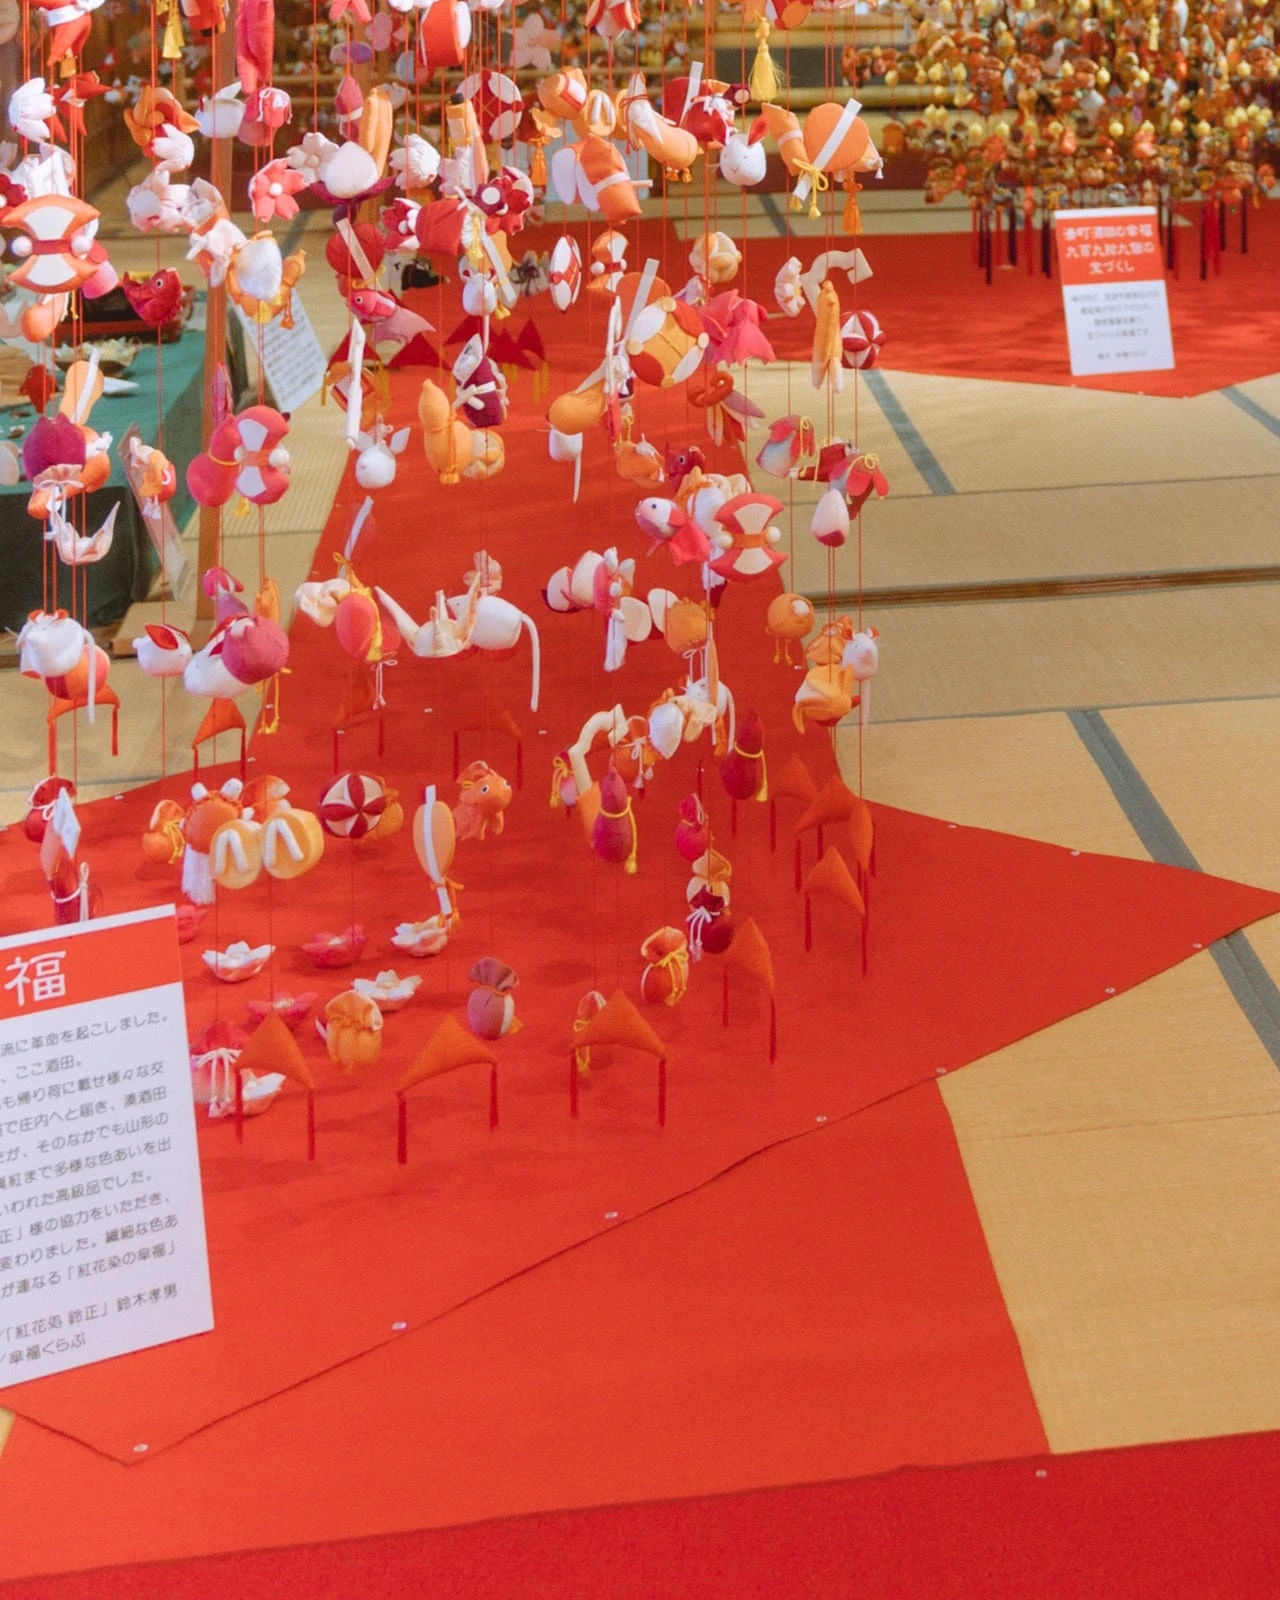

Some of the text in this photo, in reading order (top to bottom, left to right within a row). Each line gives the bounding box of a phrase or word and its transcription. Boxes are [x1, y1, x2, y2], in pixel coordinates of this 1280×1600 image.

[3, 950, 67, 1007] 福
[0, 1060, 164, 1110] も帰り荷に載せ様々な交
